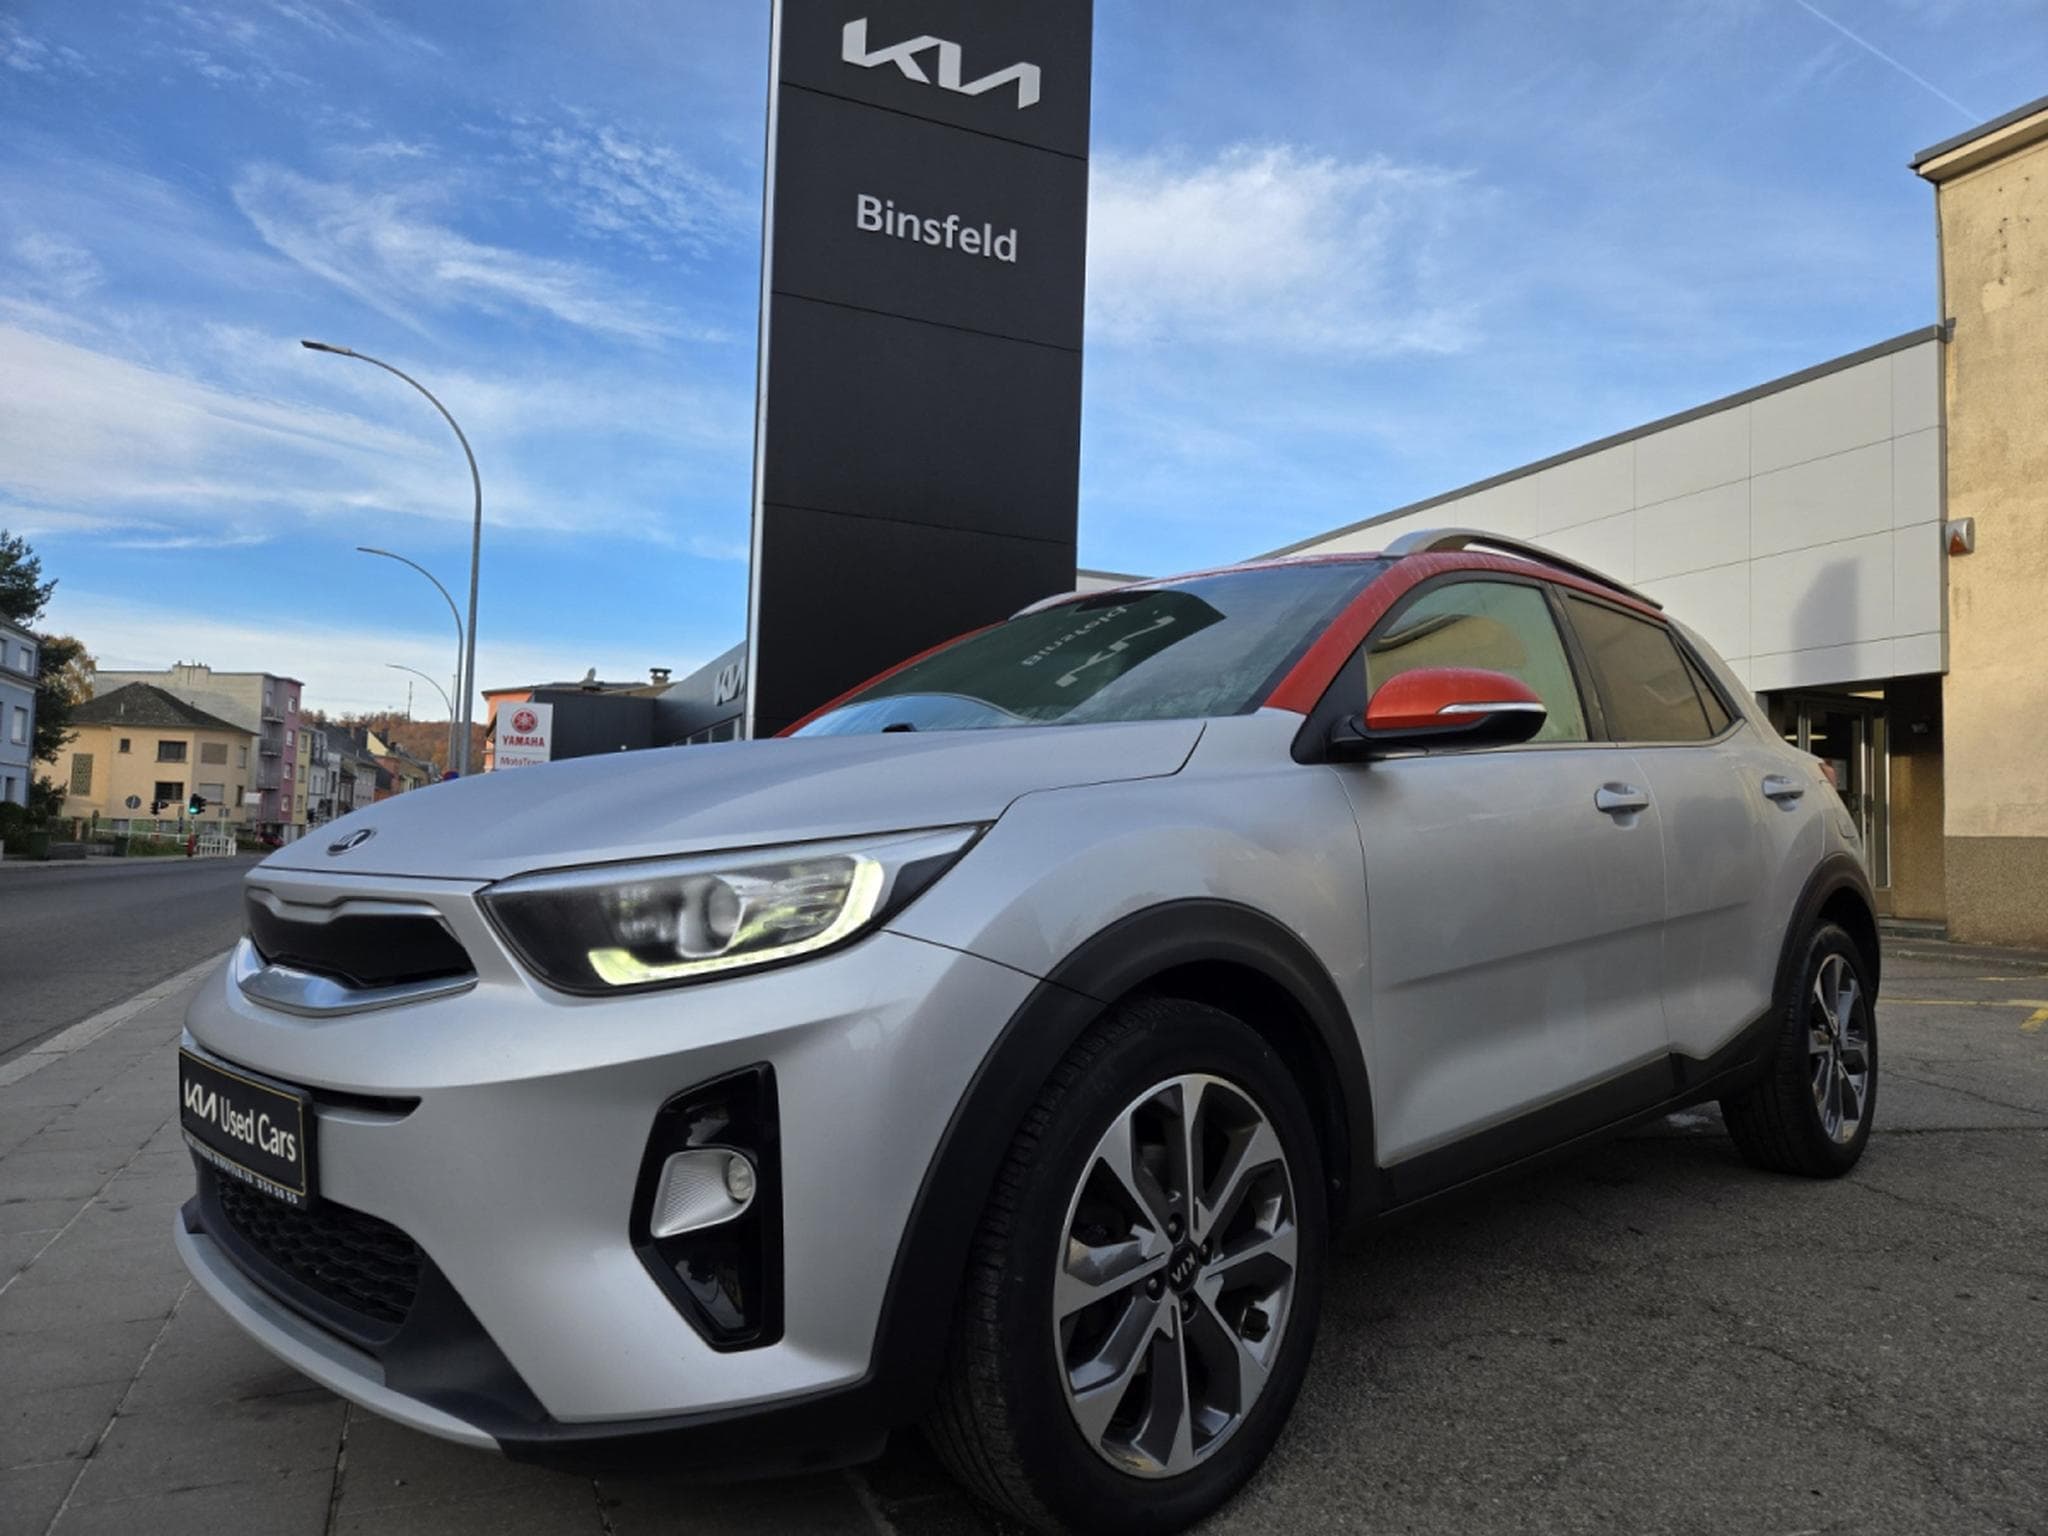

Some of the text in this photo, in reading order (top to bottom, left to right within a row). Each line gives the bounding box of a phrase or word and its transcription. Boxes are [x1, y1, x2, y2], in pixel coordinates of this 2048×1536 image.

[856, 193, 1017, 263] Binsfeld
[503, 735, 545, 747] YAMAHA
[220, 1096, 255, 1145] Used
[258, 1113, 297, 1163] Cars
[1171, 1252, 1196, 1283] KIA
